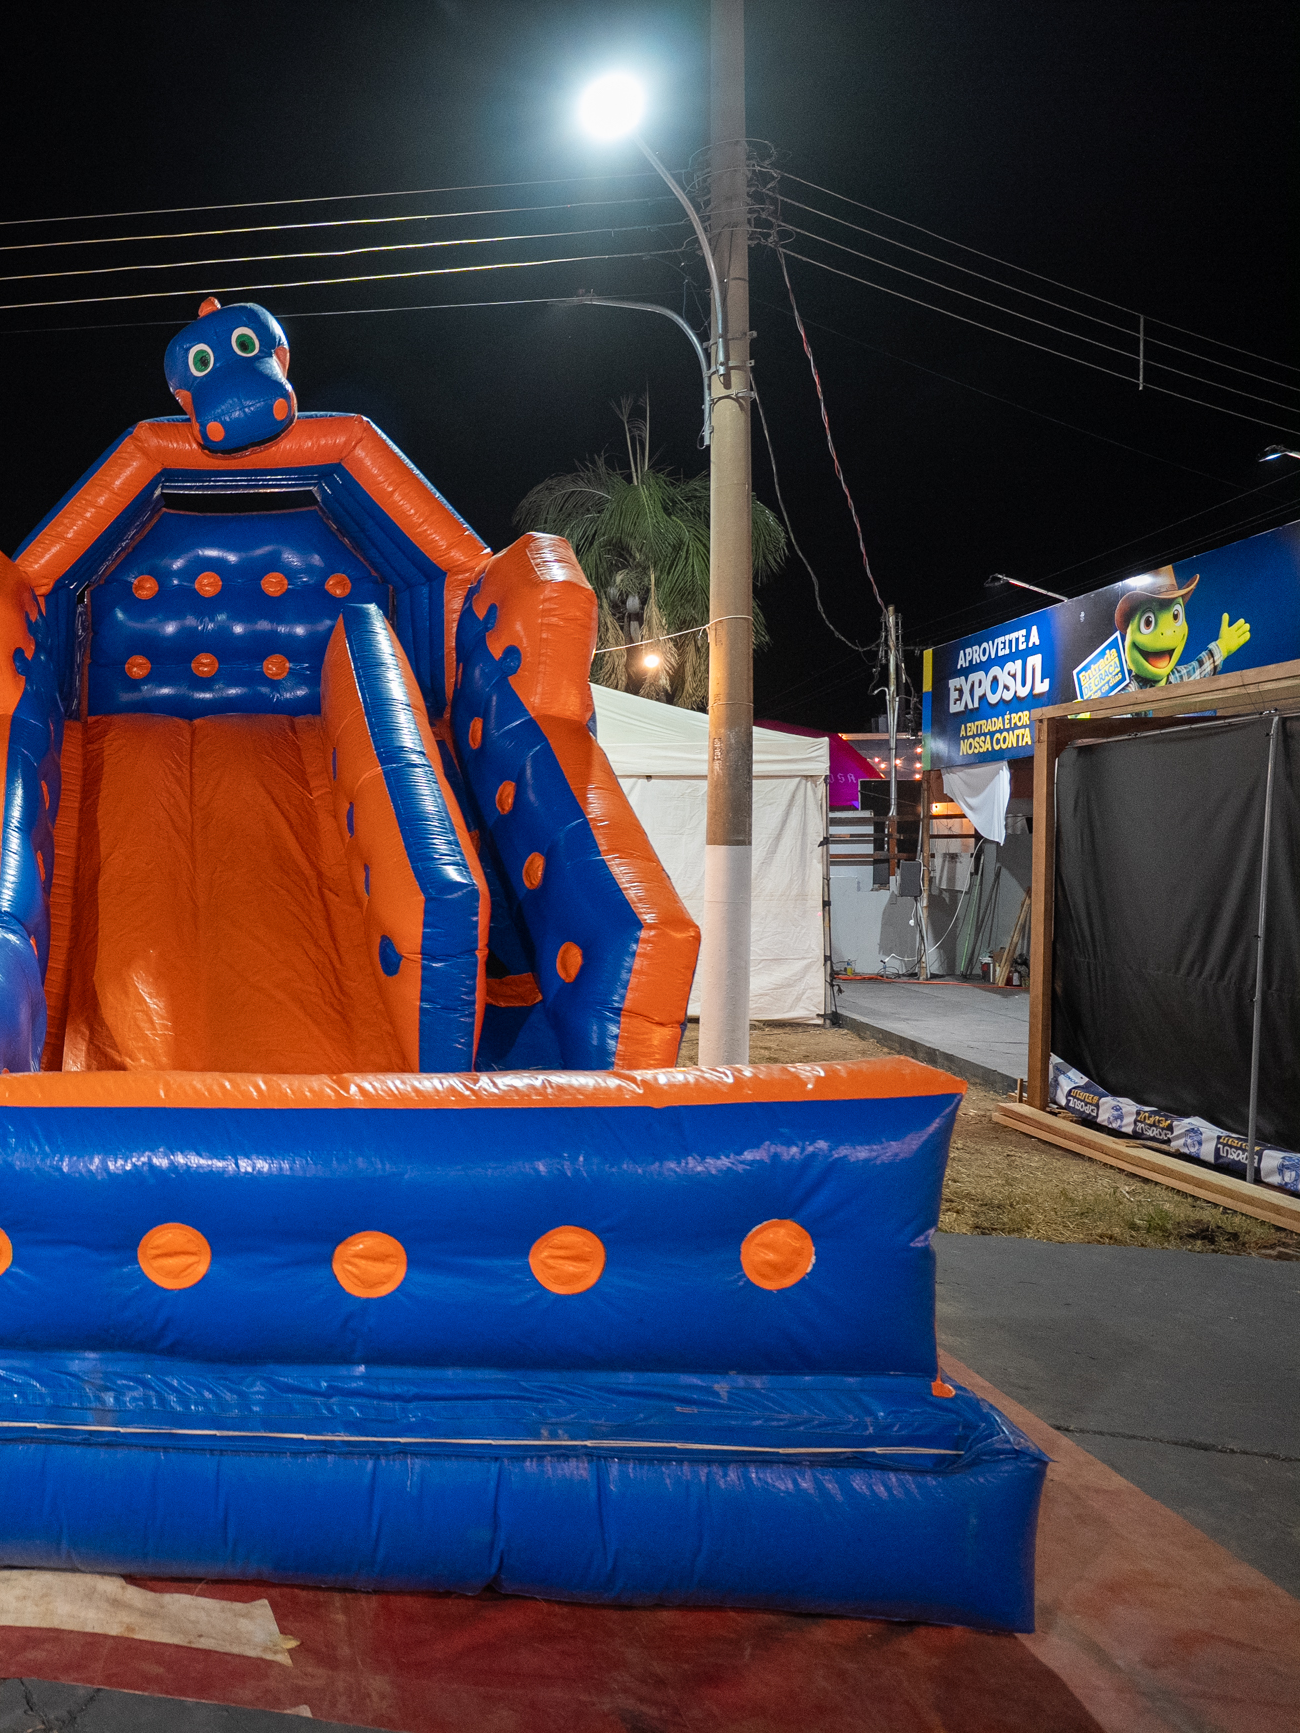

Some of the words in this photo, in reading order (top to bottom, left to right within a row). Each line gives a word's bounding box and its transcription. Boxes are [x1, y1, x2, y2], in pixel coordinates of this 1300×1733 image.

[957, 629, 1027, 669] APROVEITE
[1028, 625, 1040, 648] A
[1079, 648, 1118, 686] Entrada
[1109, 672, 1122, 687] dias
[949, 653, 1050, 713] EXPOSUL
[1083, 681, 1094, 697] DE
[960, 724, 966, 738] A
[966, 716, 1003, 736] ENTRADA
[1004, 711, 1010, 729] É
[1011, 710, 1030, 728] POR
[960, 735, 992, 755] NOSSA
[992, 728, 1031, 750] CONTA
[1067, 1097, 1098, 1117] EXPOSUL
